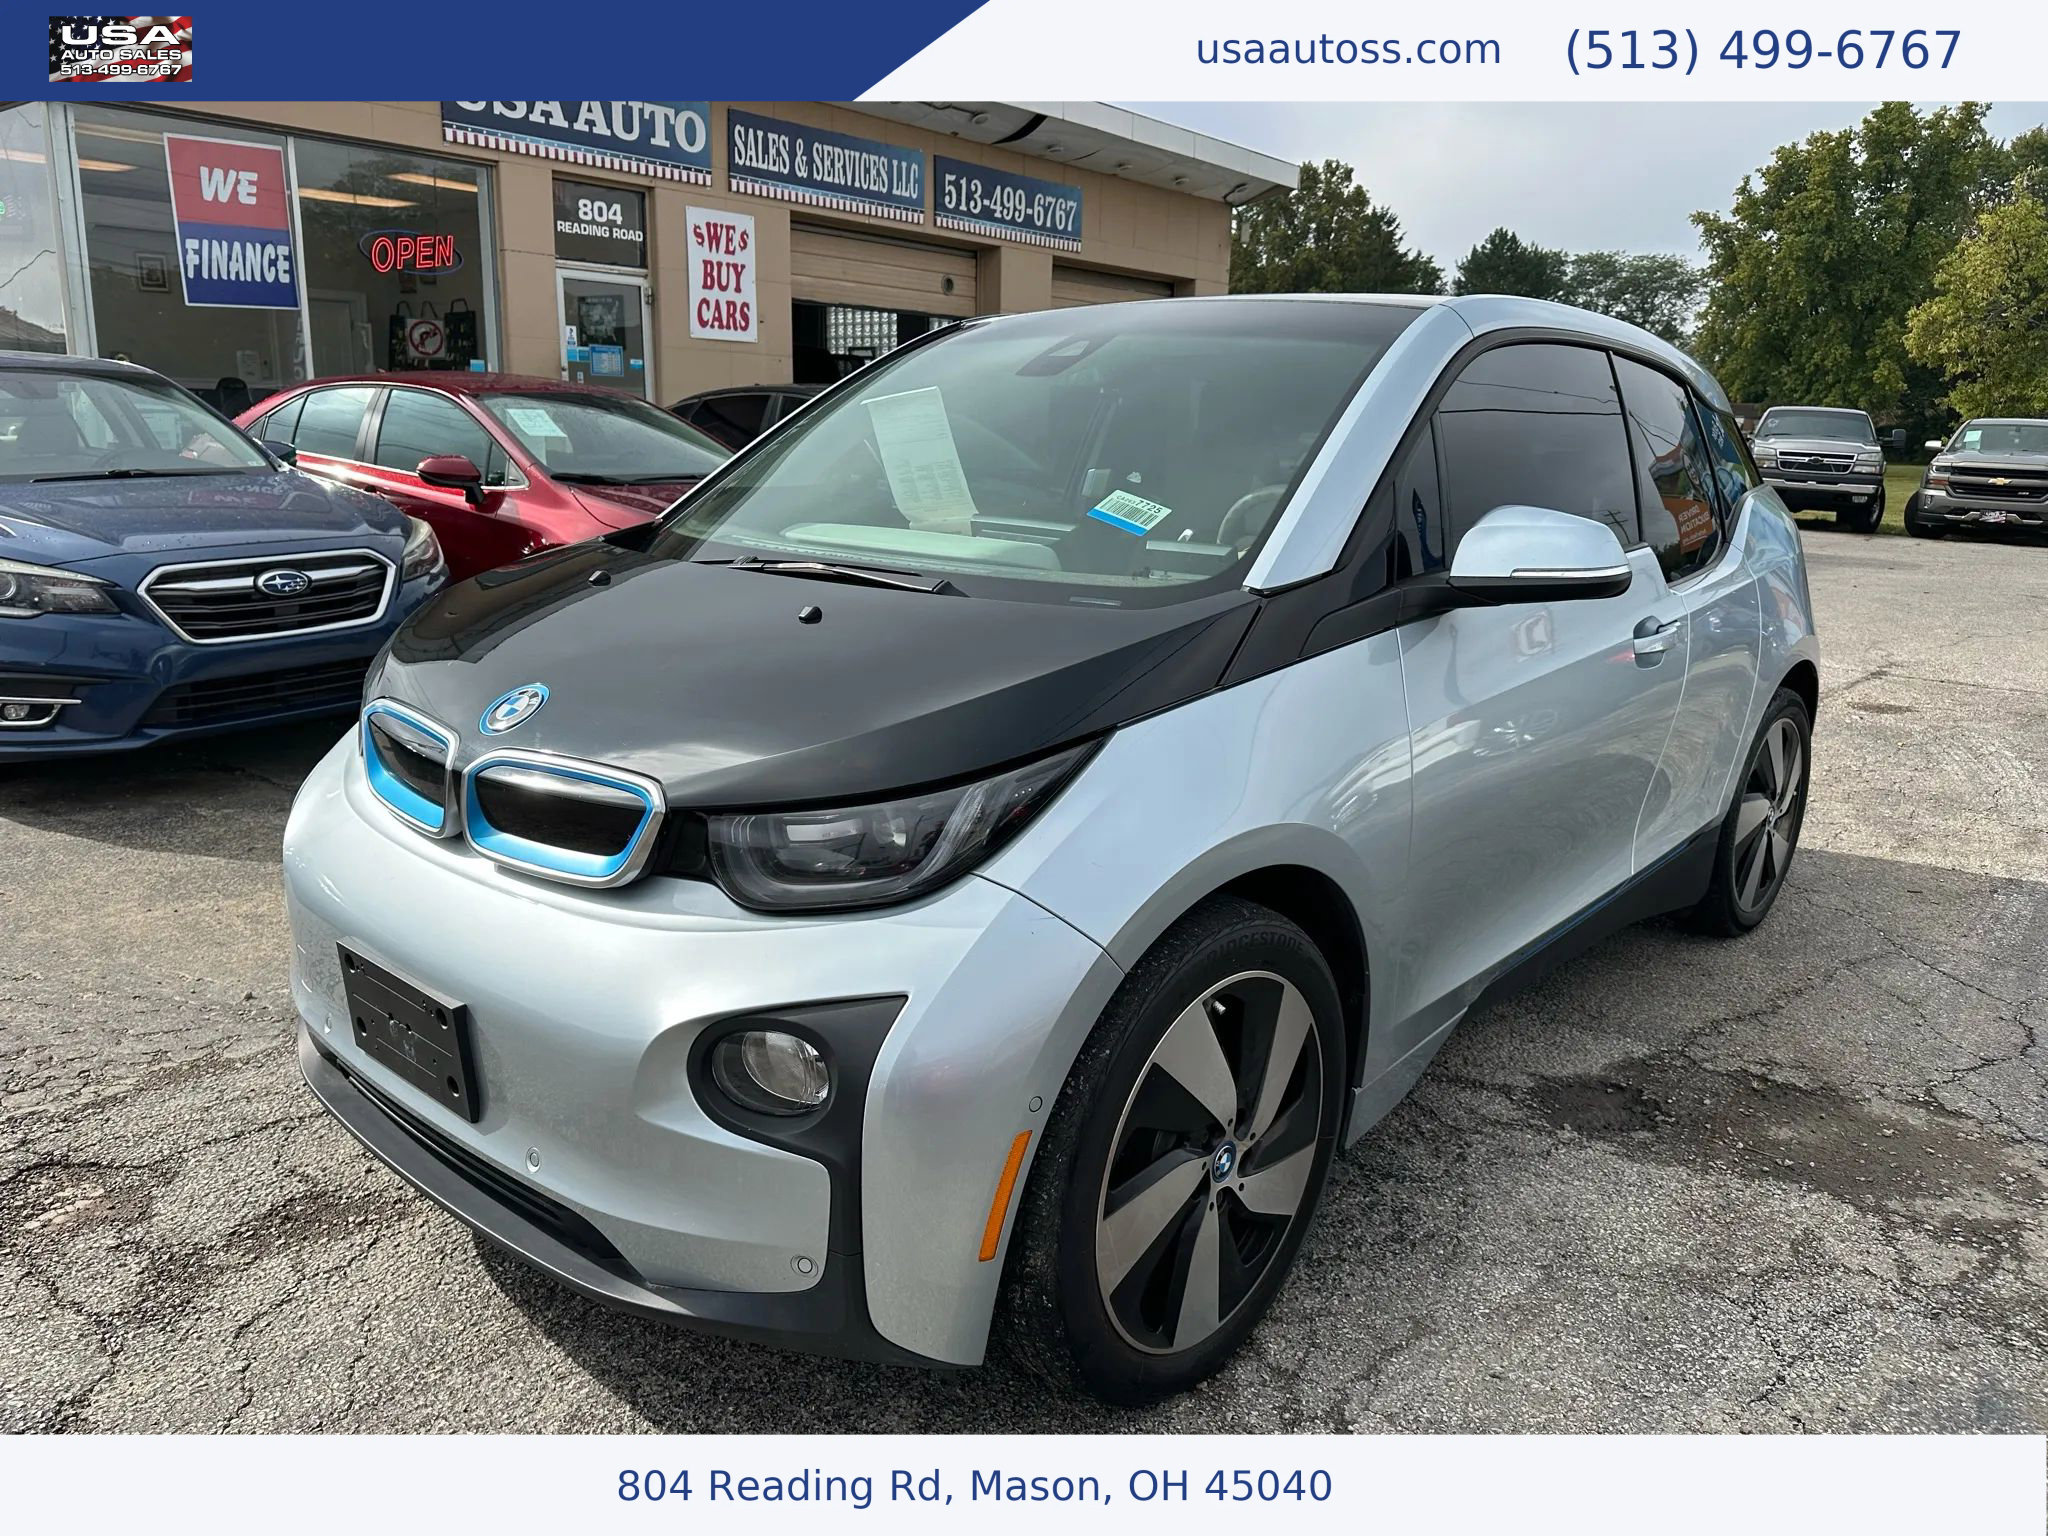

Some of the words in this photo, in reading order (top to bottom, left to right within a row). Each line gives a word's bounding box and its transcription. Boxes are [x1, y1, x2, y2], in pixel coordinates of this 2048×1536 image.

[572, 101, 707, 153] AUTO
[734, 124, 790, 175] SALES
[794, 138, 808, 179] &
[812, 141, 888, 193] SERVICES
[892, 159, 919, 199] LLC
[200, 165, 258, 205] WE
[944, 173, 1077, 232] 513-499-6767
[578, 198, 623, 224] 804
[556, 220, 610, 238] READING
[612, 227, 644, 242] ROAD
[185, 238, 290, 283] FINANCE
[371, 234, 454, 273] OPEN
[702, 259, 746, 294] BUY
[697, 297, 750, 332] CARS
[1203, 931, 1305, 963] RIDGESTONE
